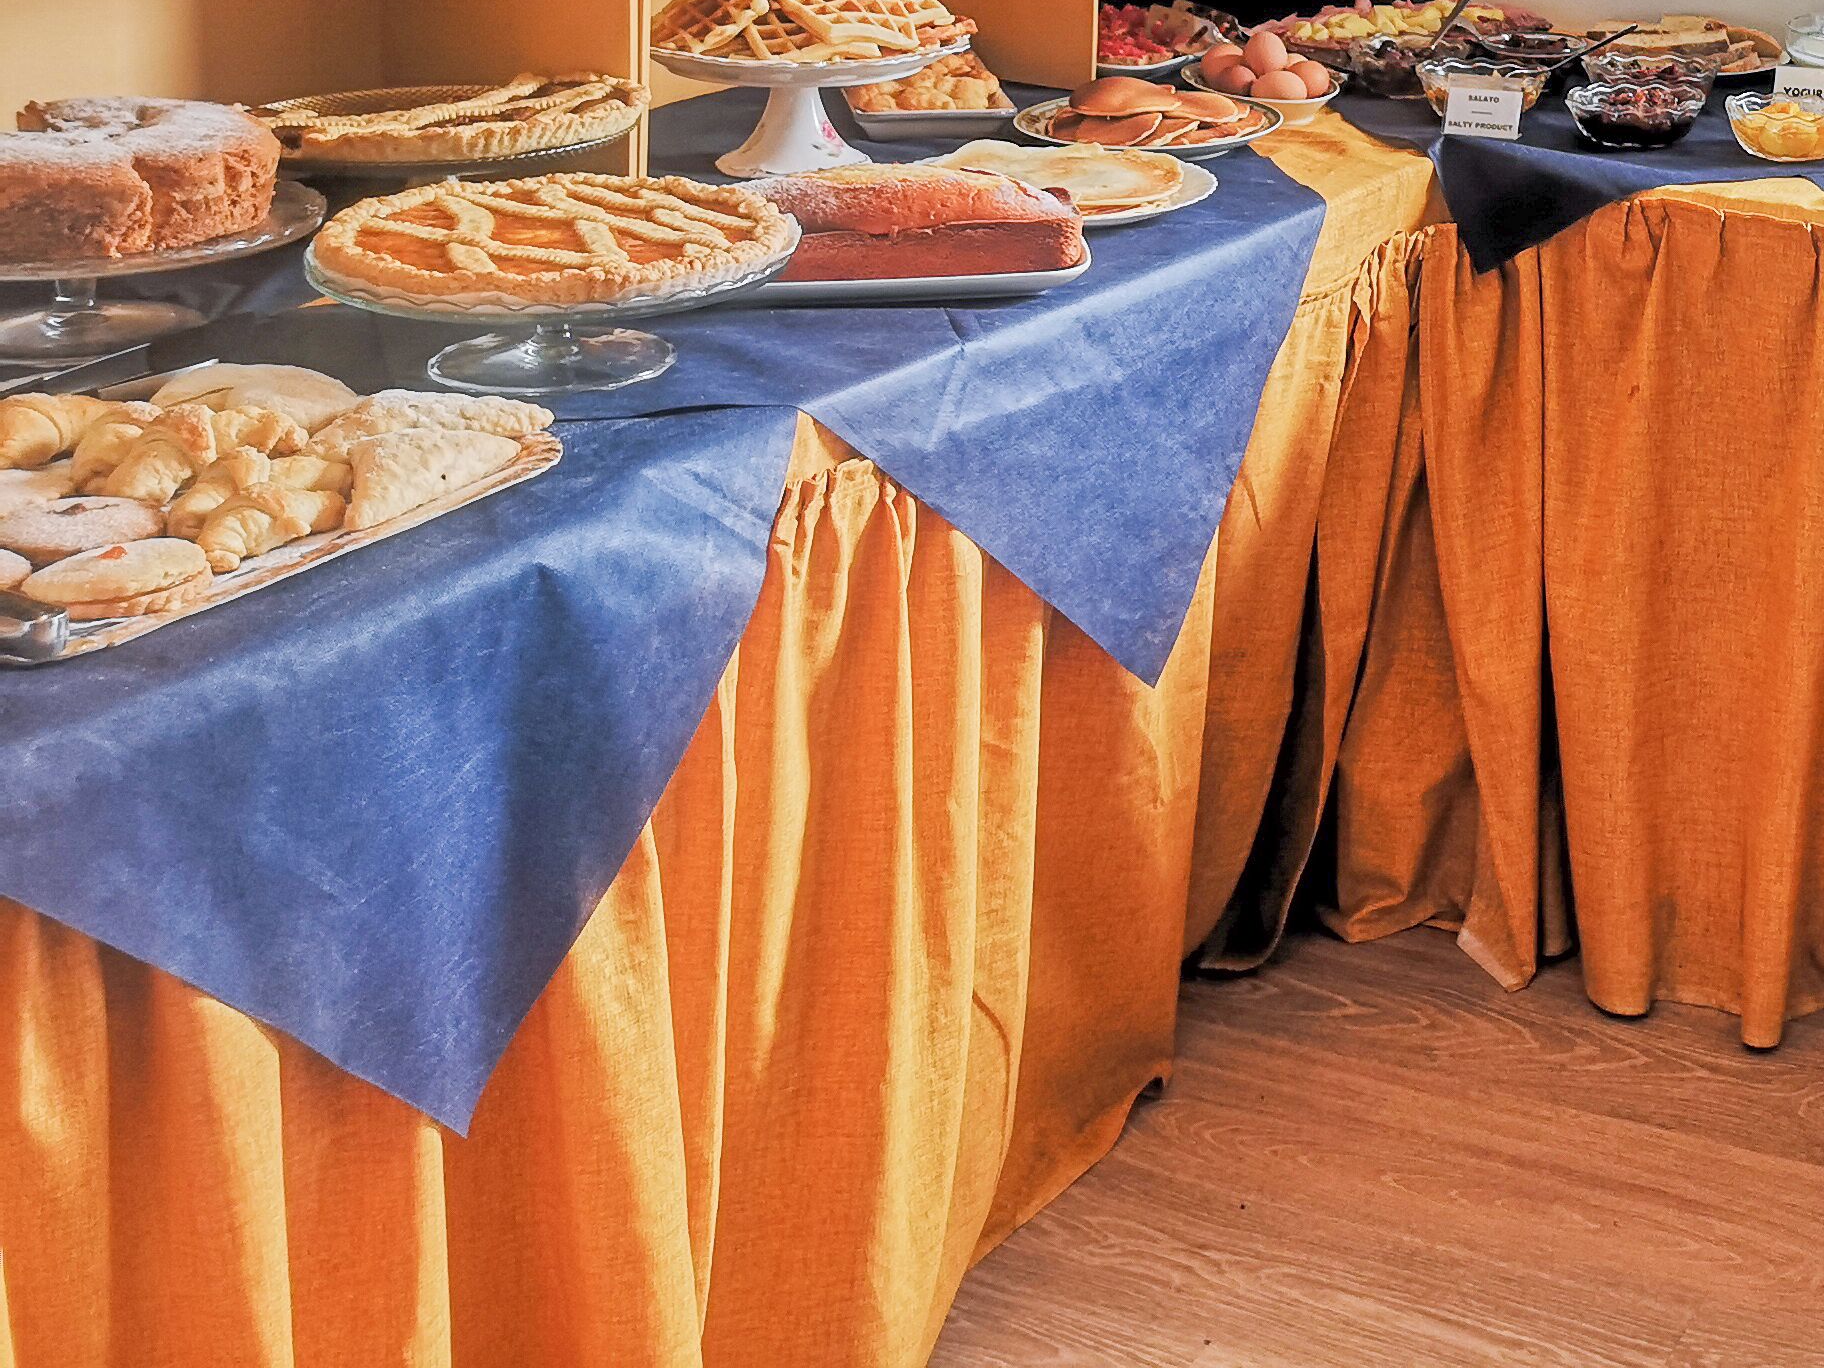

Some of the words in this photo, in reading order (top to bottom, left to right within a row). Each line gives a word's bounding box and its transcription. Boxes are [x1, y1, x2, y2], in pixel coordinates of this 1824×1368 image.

[1468, 95, 1500, 104] SALATO
[1448, 120, 1473, 129] SALTY
[1475, 122, 1513, 132] PRODUCT
